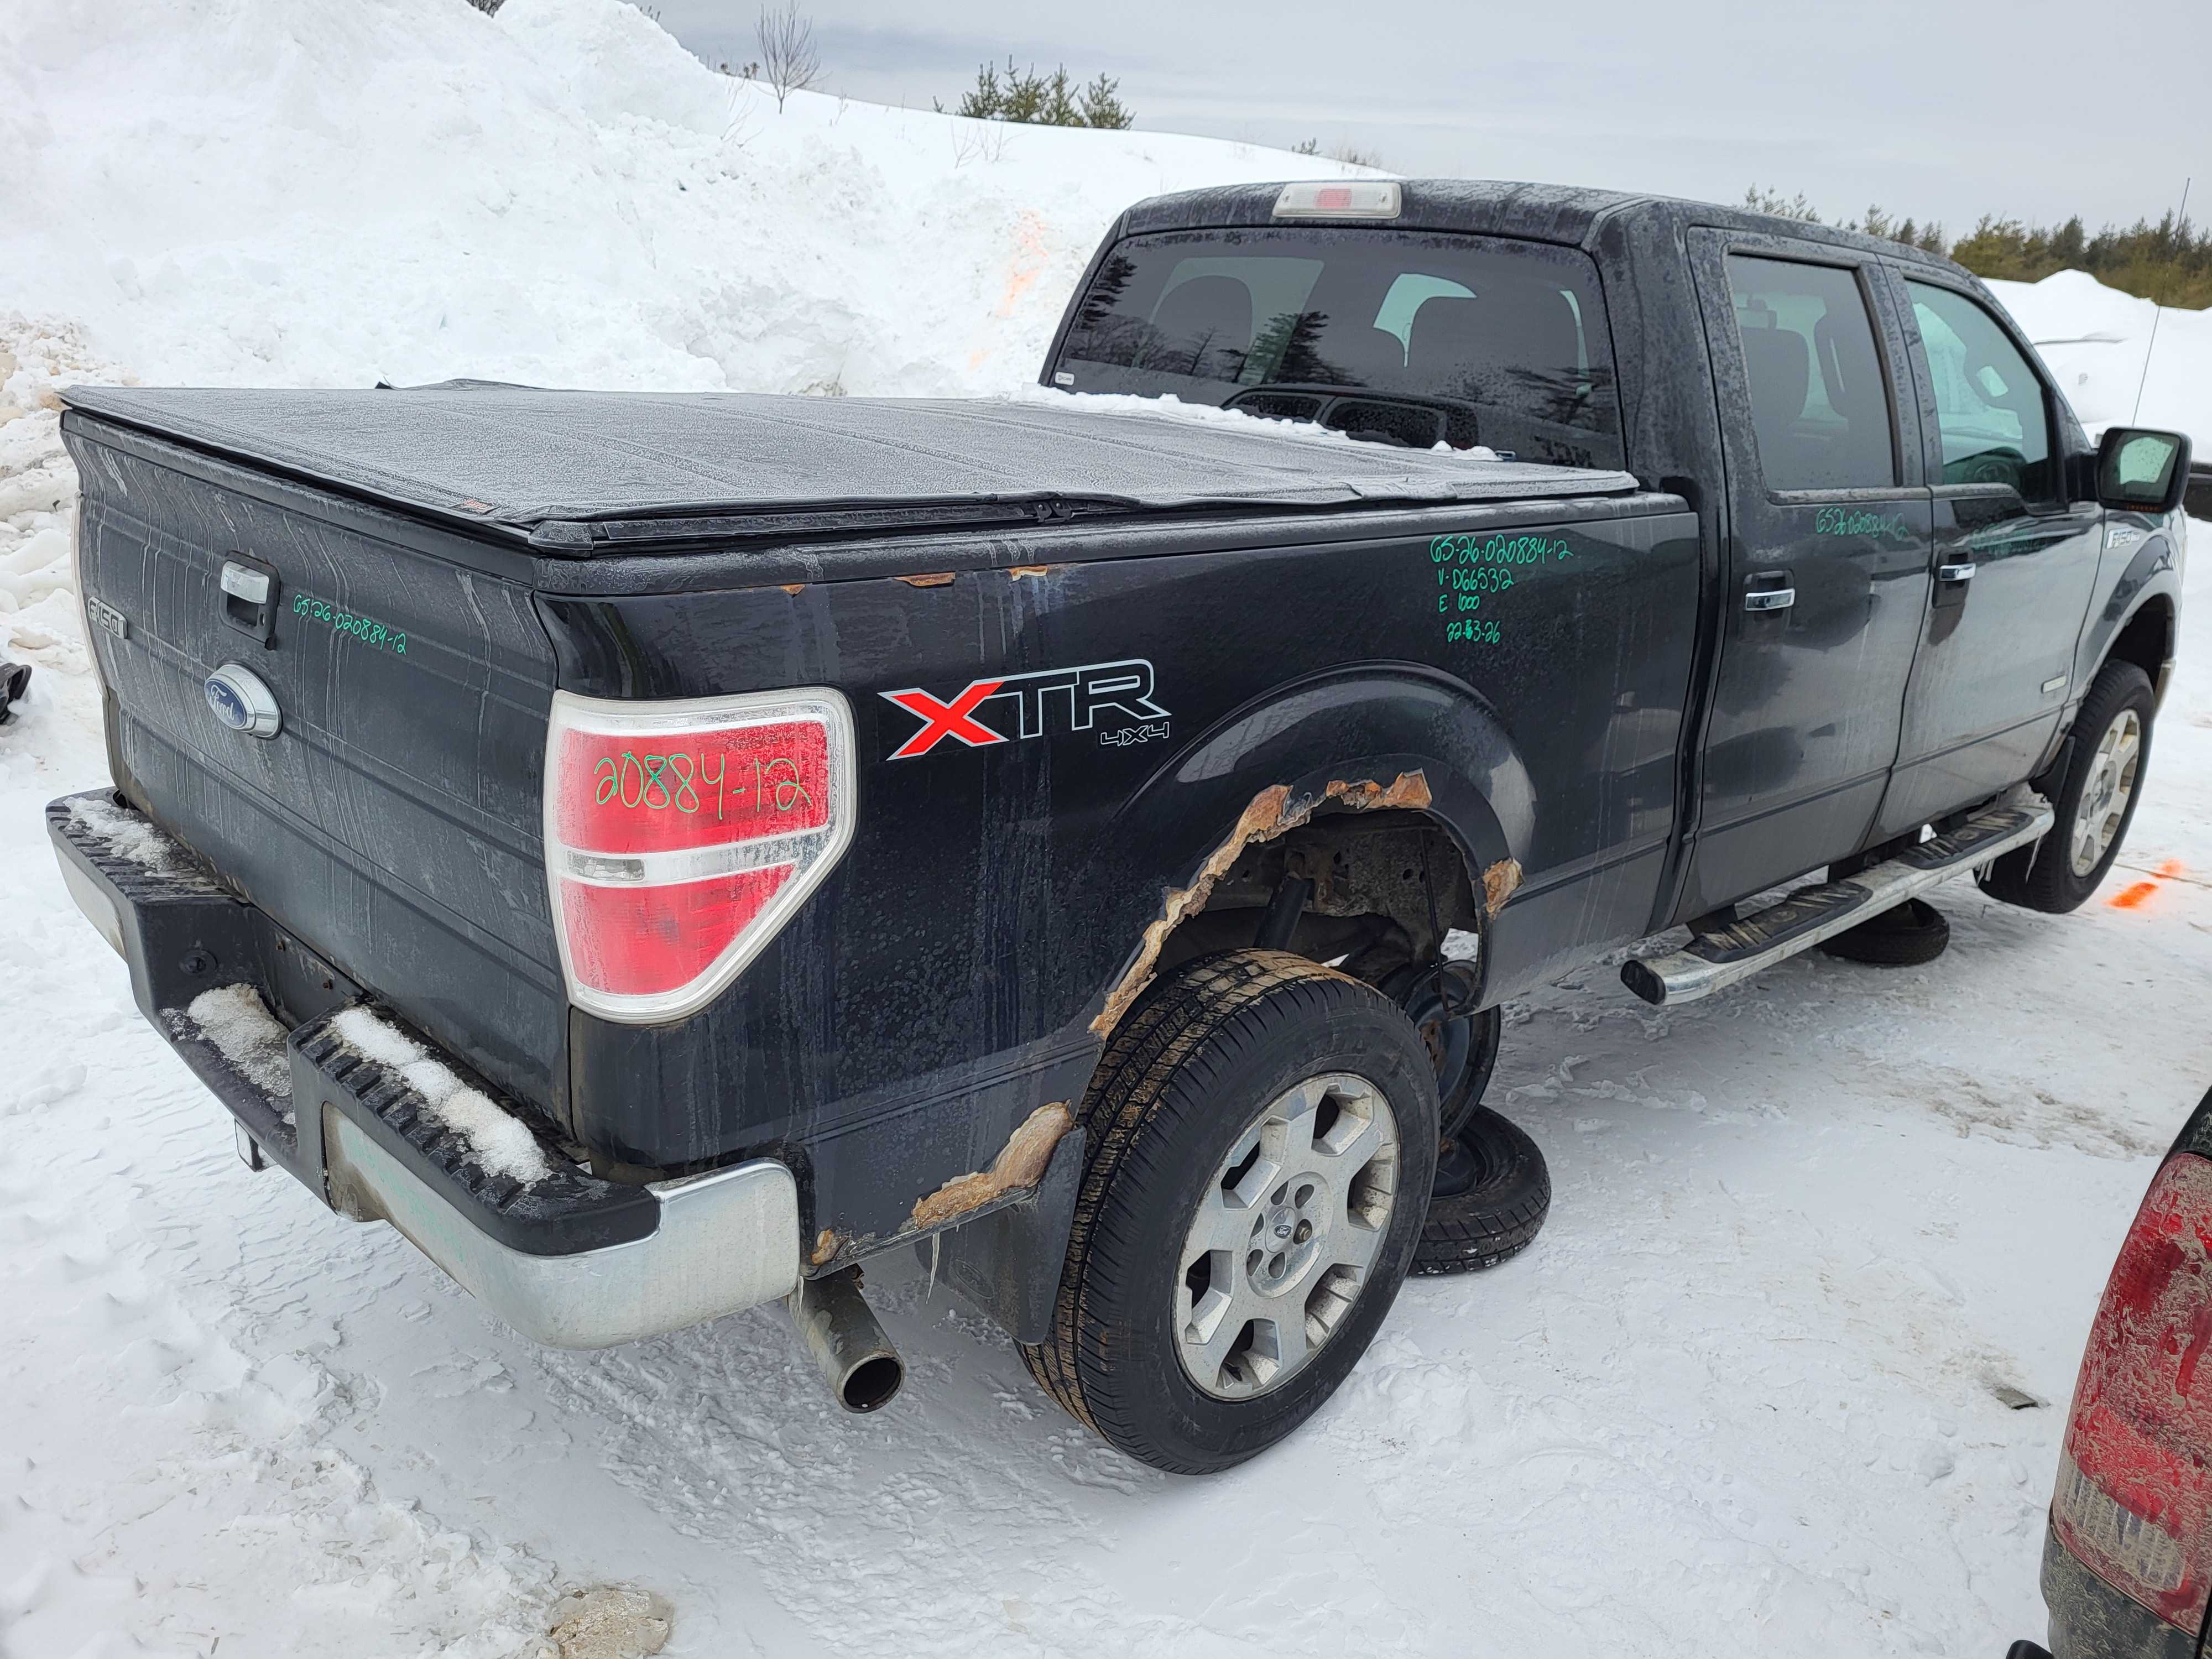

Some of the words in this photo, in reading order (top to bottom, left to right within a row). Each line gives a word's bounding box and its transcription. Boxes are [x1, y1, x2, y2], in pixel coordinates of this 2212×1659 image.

[1439, 594, 1448, 612] E
[210, 684, 235, 721] Ford
[877, 659, 1172, 761] XTR
[594, 751, 812, 820] 20884-12
